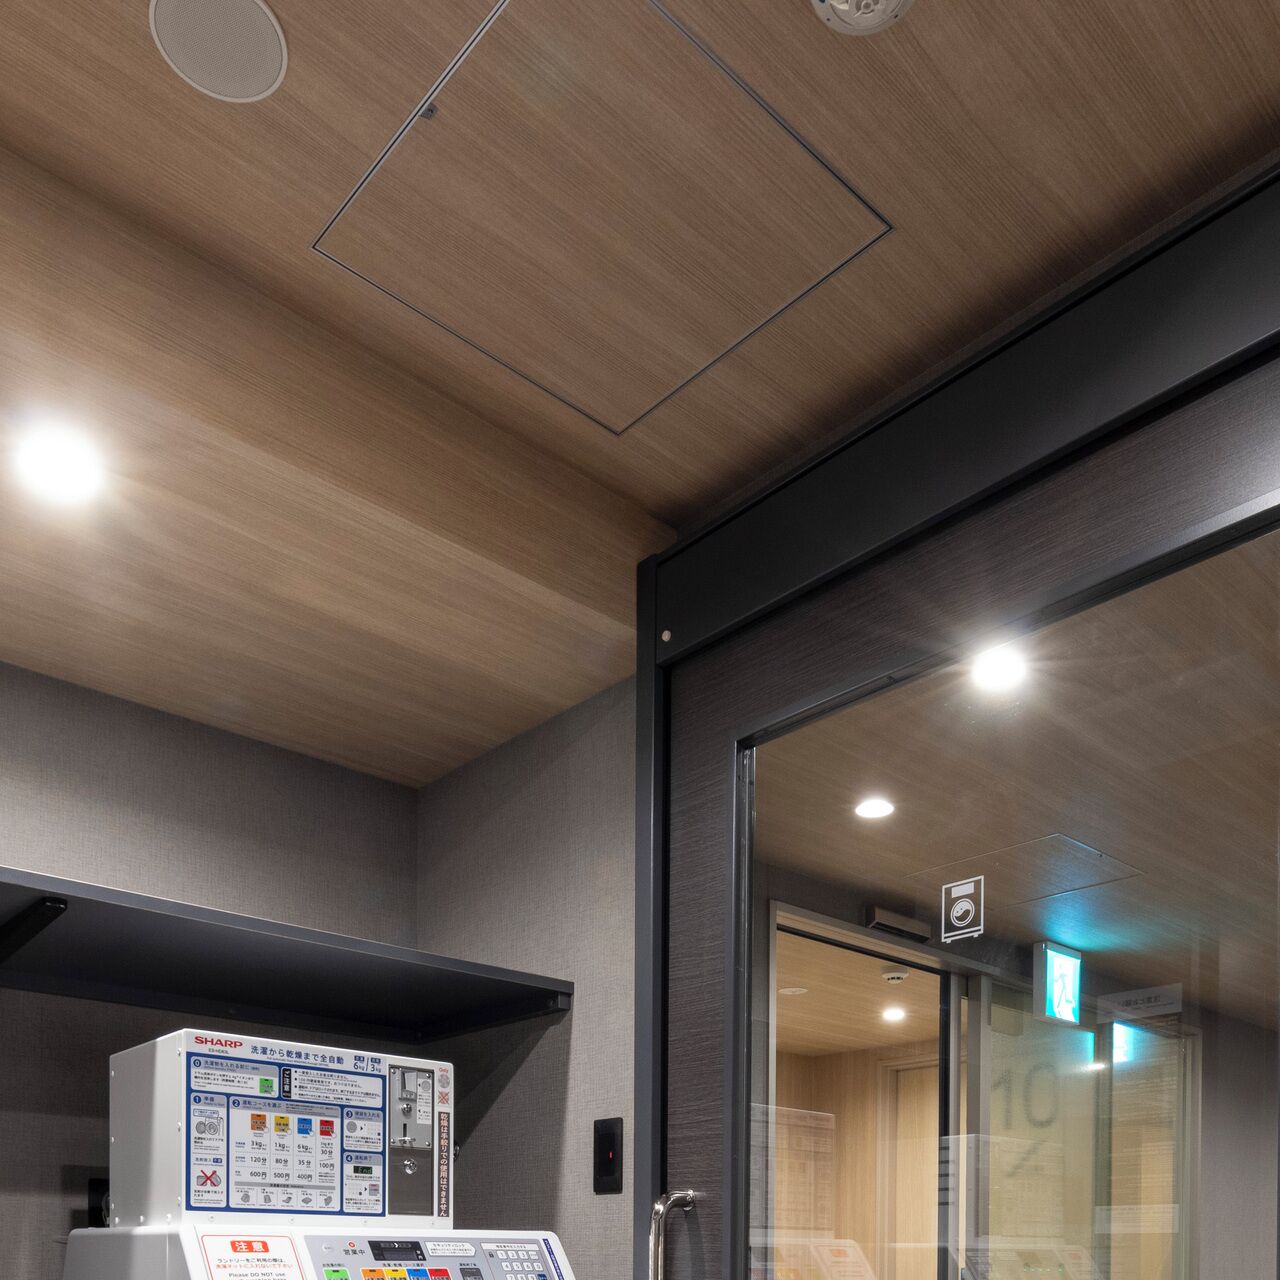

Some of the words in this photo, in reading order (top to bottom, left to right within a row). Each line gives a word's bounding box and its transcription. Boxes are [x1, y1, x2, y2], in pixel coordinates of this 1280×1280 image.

[194, 1036, 243, 1048] SHARP
[250, 1045, 344, 1065] 洗濯から乾燥まで全自動
[236, 1242, 265, 1252] 注意
